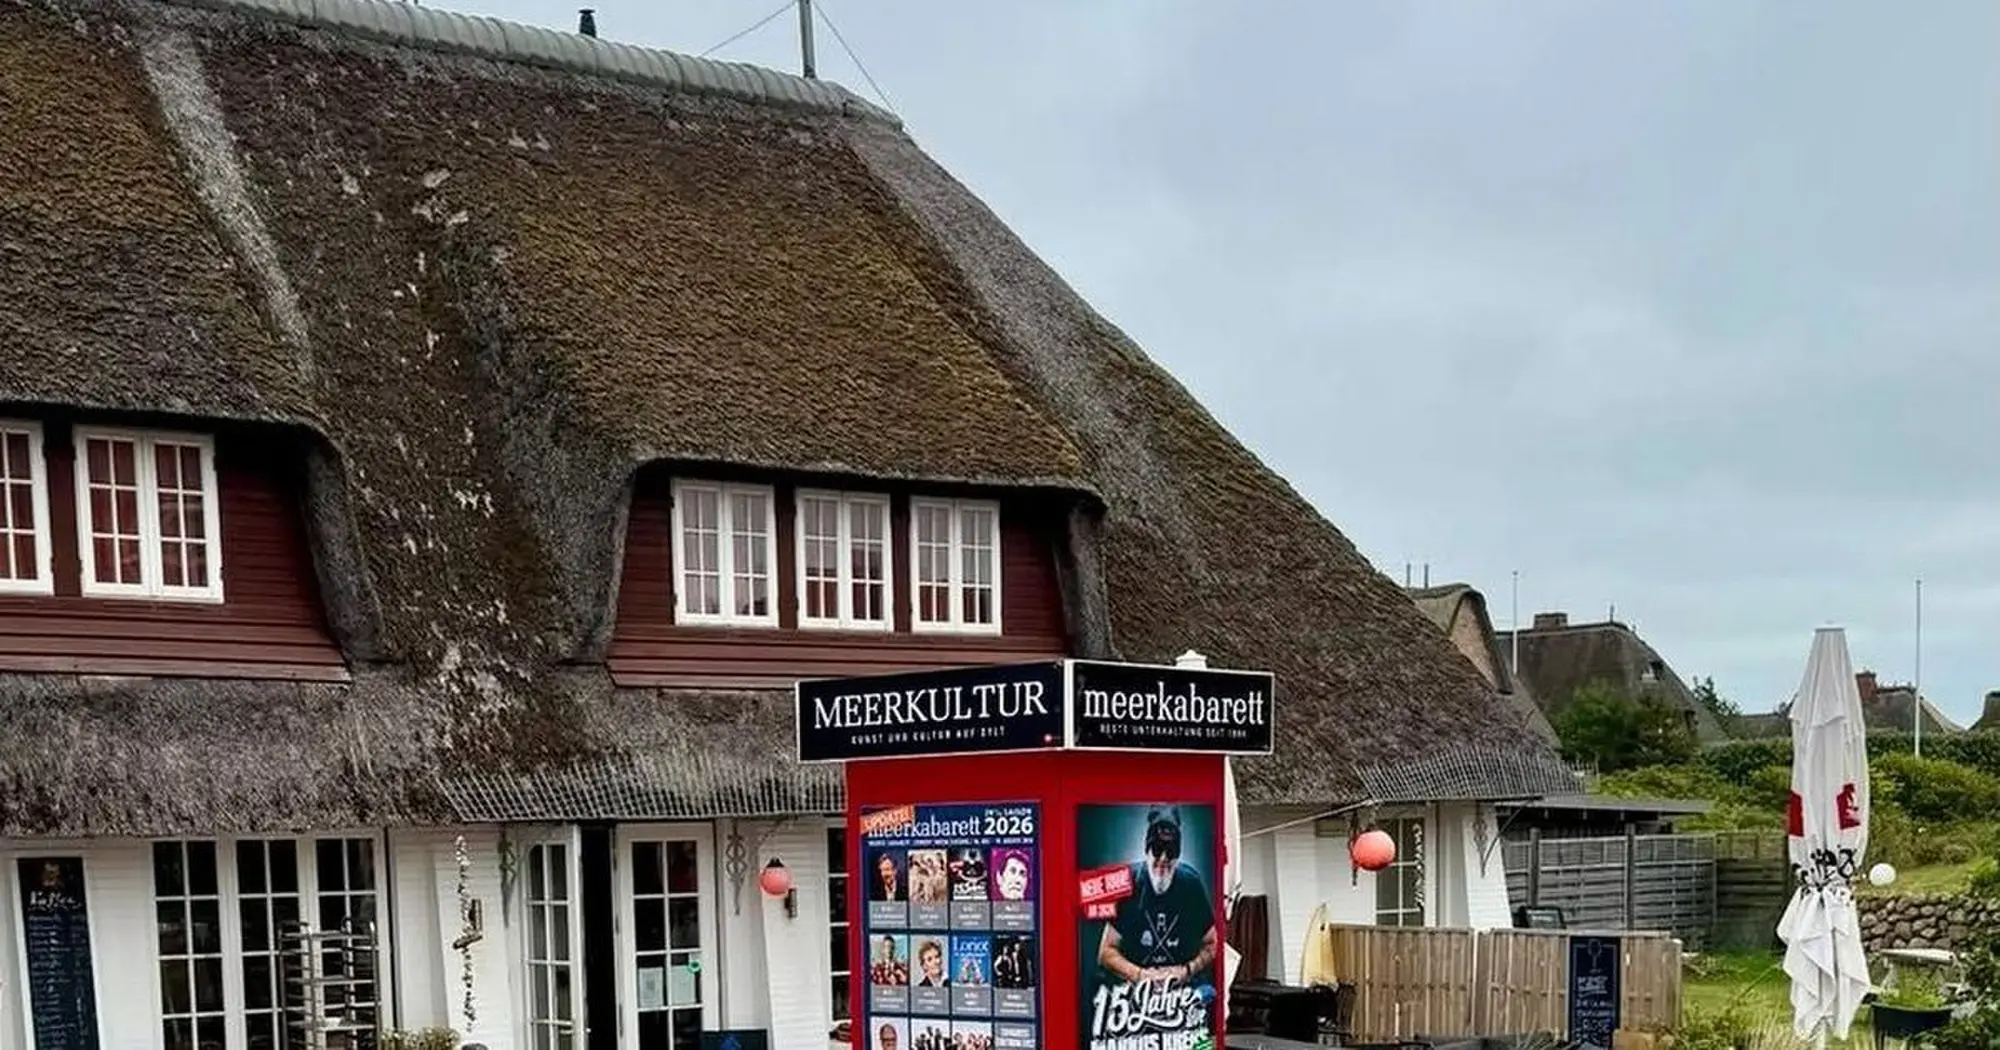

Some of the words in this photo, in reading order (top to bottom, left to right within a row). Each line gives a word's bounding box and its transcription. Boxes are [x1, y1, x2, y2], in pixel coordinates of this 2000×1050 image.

[814, 680, 1048, 729] MEERKULTUR
[1083, 680, 1265, 725] meerkabarett
[850, 732, 883, 745] KUNST
[912, 728, 951, 742] KULTUR
[868, 813, 981, 838] meerkabarett
[983, 816, 1034, 836] 2026
[1092, 983, 1130, 1037] 15
[1127, 974, 1201, 1032] Jahre
